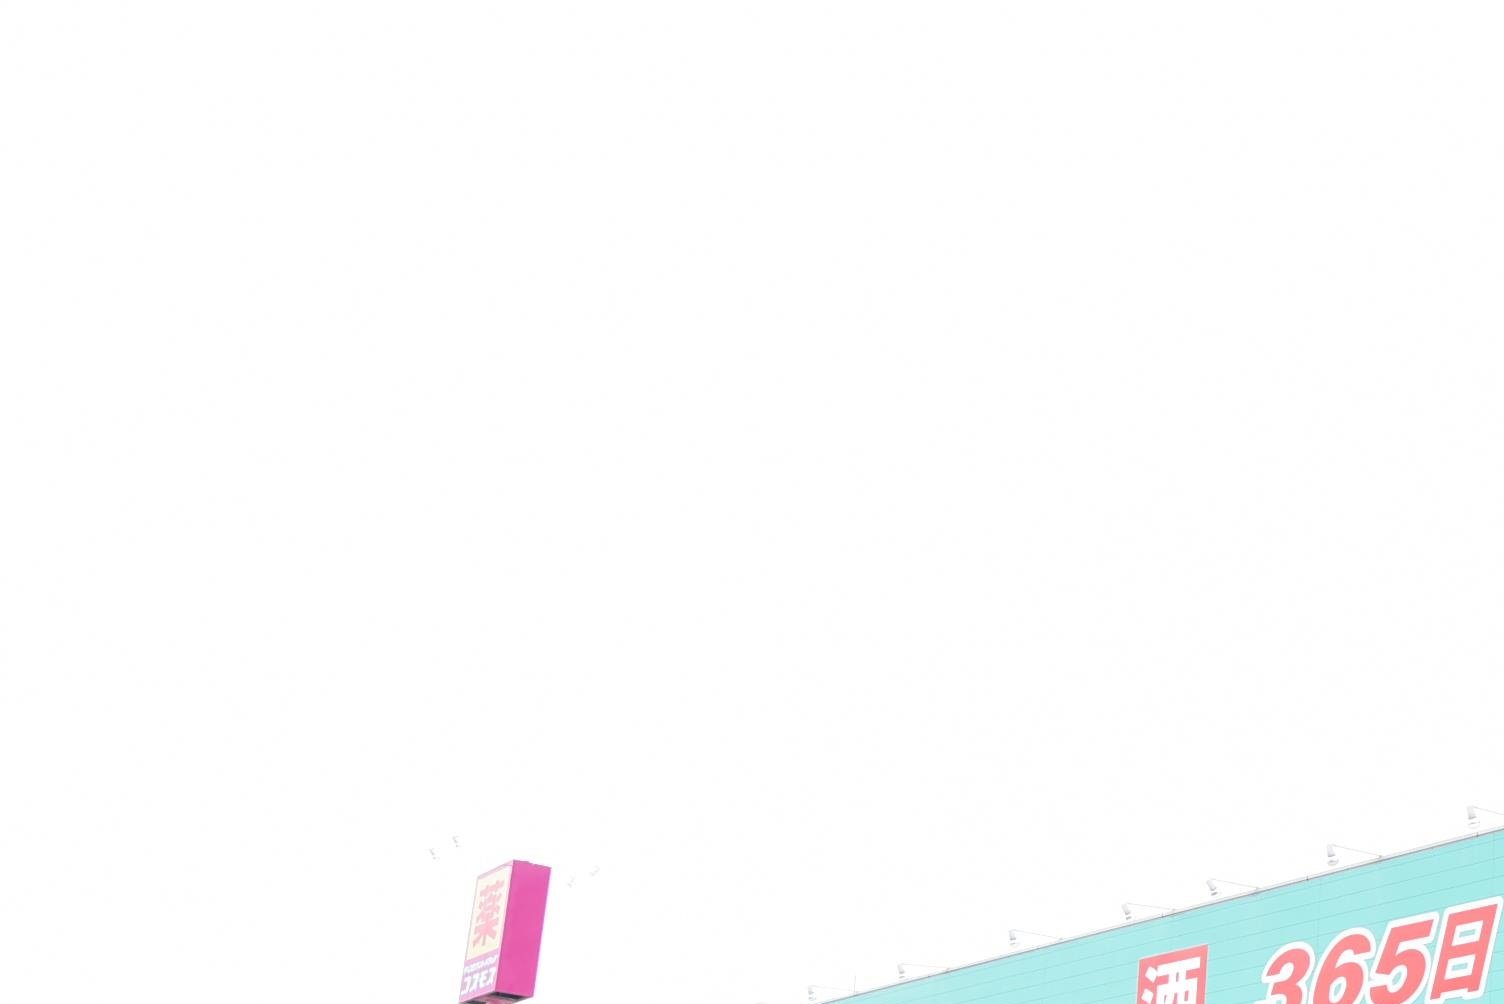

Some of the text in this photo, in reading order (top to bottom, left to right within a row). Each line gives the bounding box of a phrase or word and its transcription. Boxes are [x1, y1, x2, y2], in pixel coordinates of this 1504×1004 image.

[473, 879, 504, 947] 薬
[461, 966, 498, 997] コスモス
